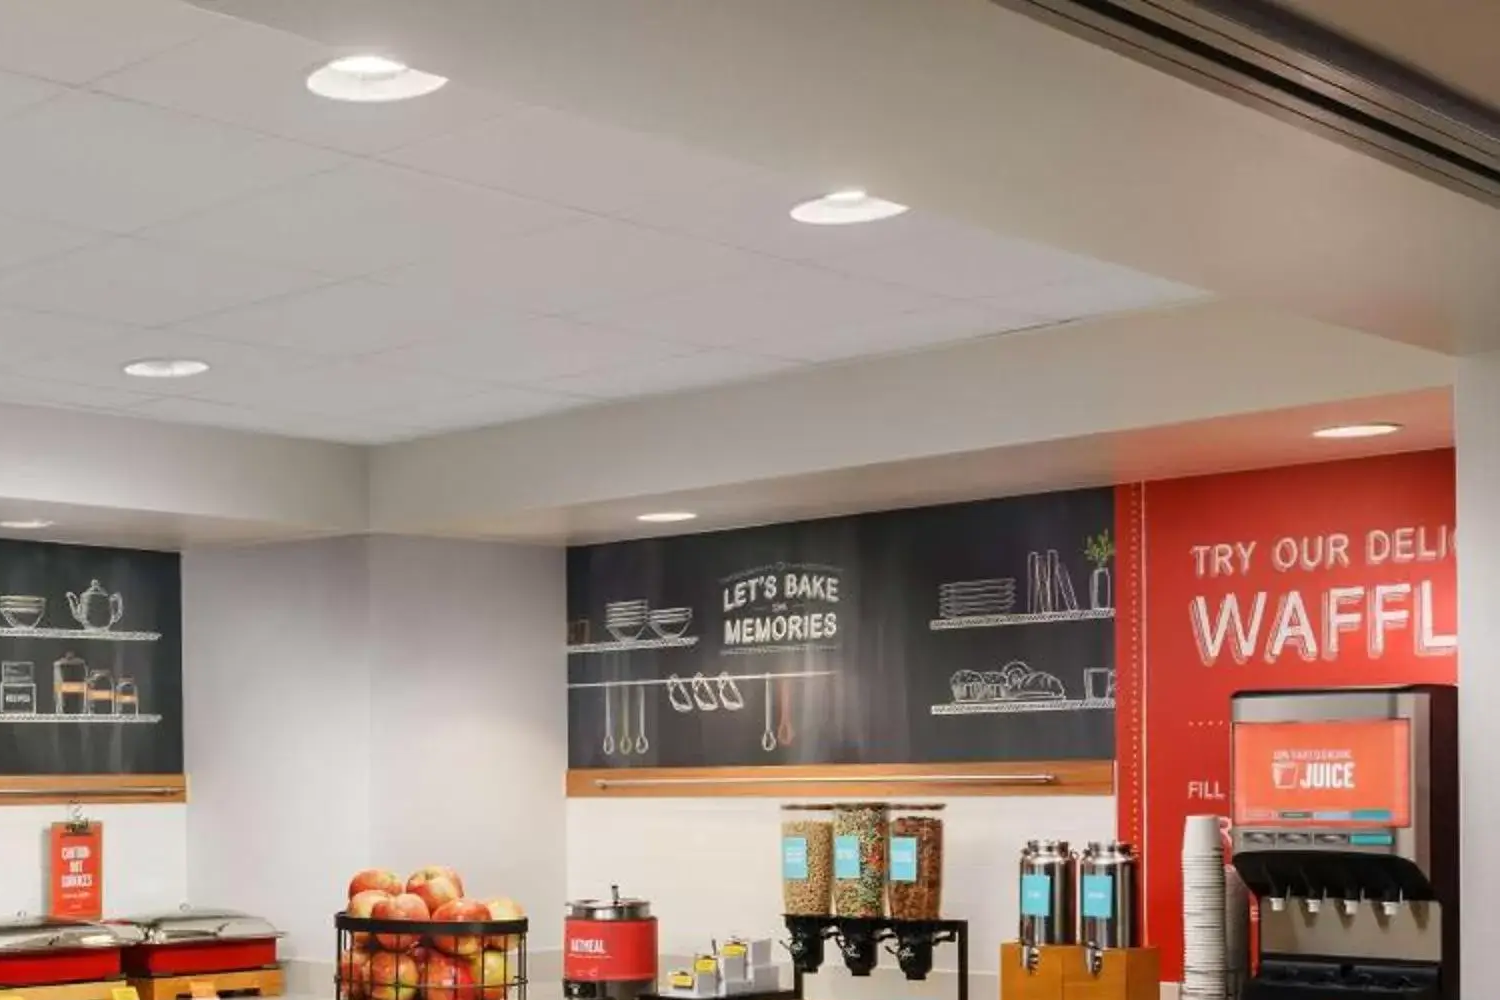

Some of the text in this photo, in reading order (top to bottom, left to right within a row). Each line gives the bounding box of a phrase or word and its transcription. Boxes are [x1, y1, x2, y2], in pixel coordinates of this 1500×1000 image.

[1191, 541, 1257, 578] TRY
[1272, 533, 1350, 572] OUR
[723, 573, 839, 612] LET'S BAKE
[724, 612, 837, 645] MEMORIES
[1187, 780, 1226, 799] FILL
[1300, 762, 1355, 789] JUICE
